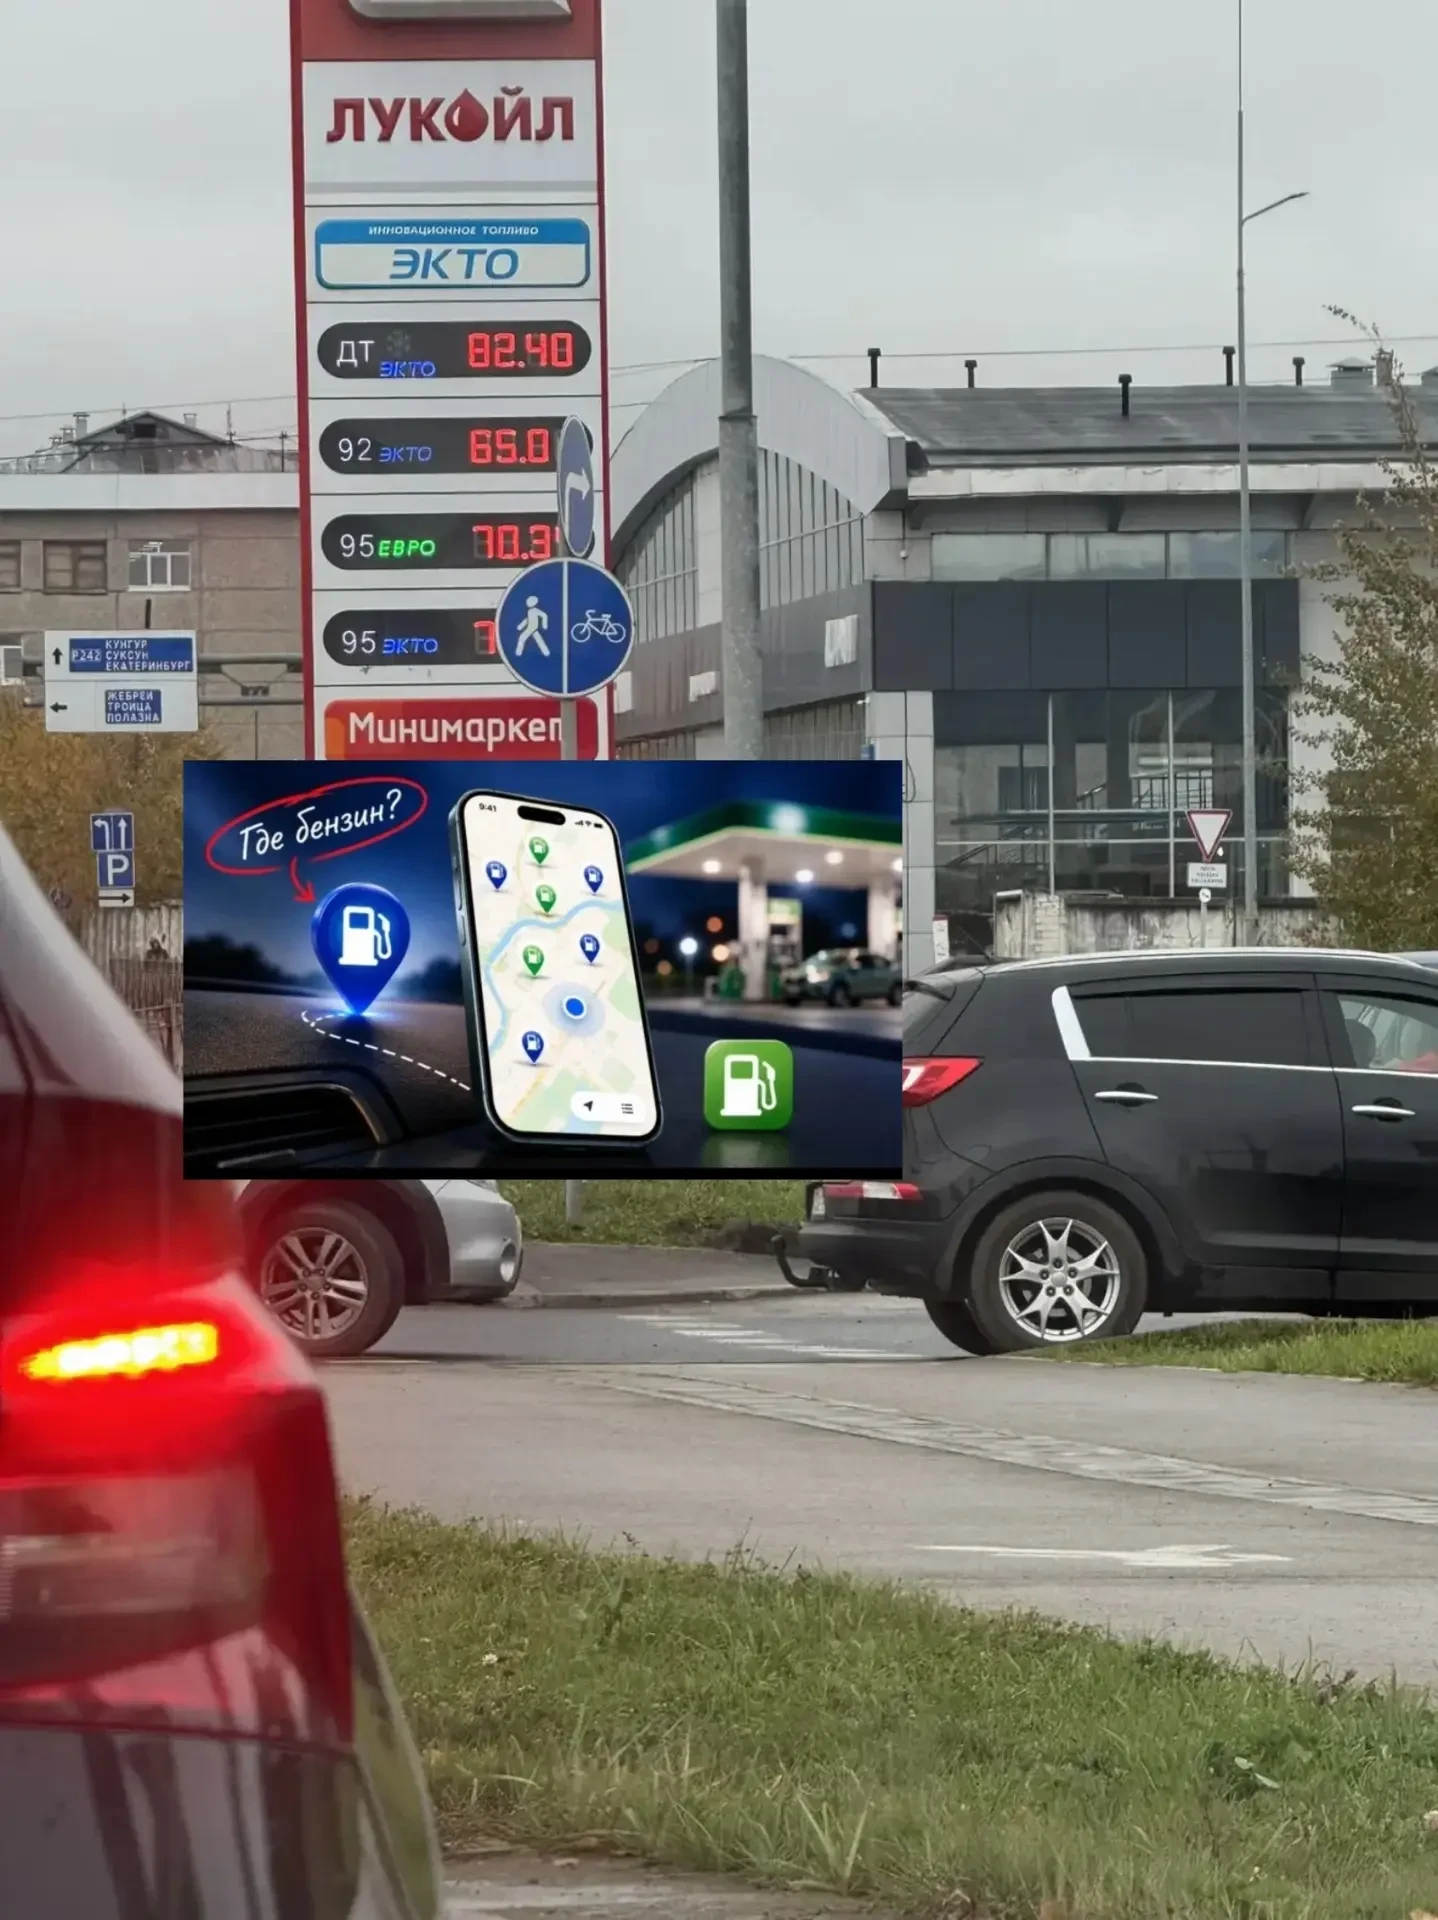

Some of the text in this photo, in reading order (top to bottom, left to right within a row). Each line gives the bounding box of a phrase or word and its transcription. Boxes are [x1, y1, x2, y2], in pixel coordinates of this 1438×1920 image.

[325, 85, 574, 142] ЛУКОЙЛ
[368, 225, 539, 236] ИННОВАЦИОННОЕ ТОПЛИВО
[389, 248, 519, 280] ЭКТО
[336, 332, 574, 378] ДТ ЭКТО 82.40
[338, 429, 550, 463] 92 ЭКТО 65.0
[340, 525, 560, 560] 95 ЕВРО 70.3
[342, 620, 496, 655] 95 ЭКТО 7
[105, 640, 148, 650] КУНГУР
[71, 650, 101, 661] Р242
[105, 650, 149, 660] СУКСУН
[105, 661, 191, 671] ЕКАТЕРИНБУРГ
[107, 702, 151, 712] ТРОИЦА
[107, 713, 160, 722] ПОЛАЗНА
